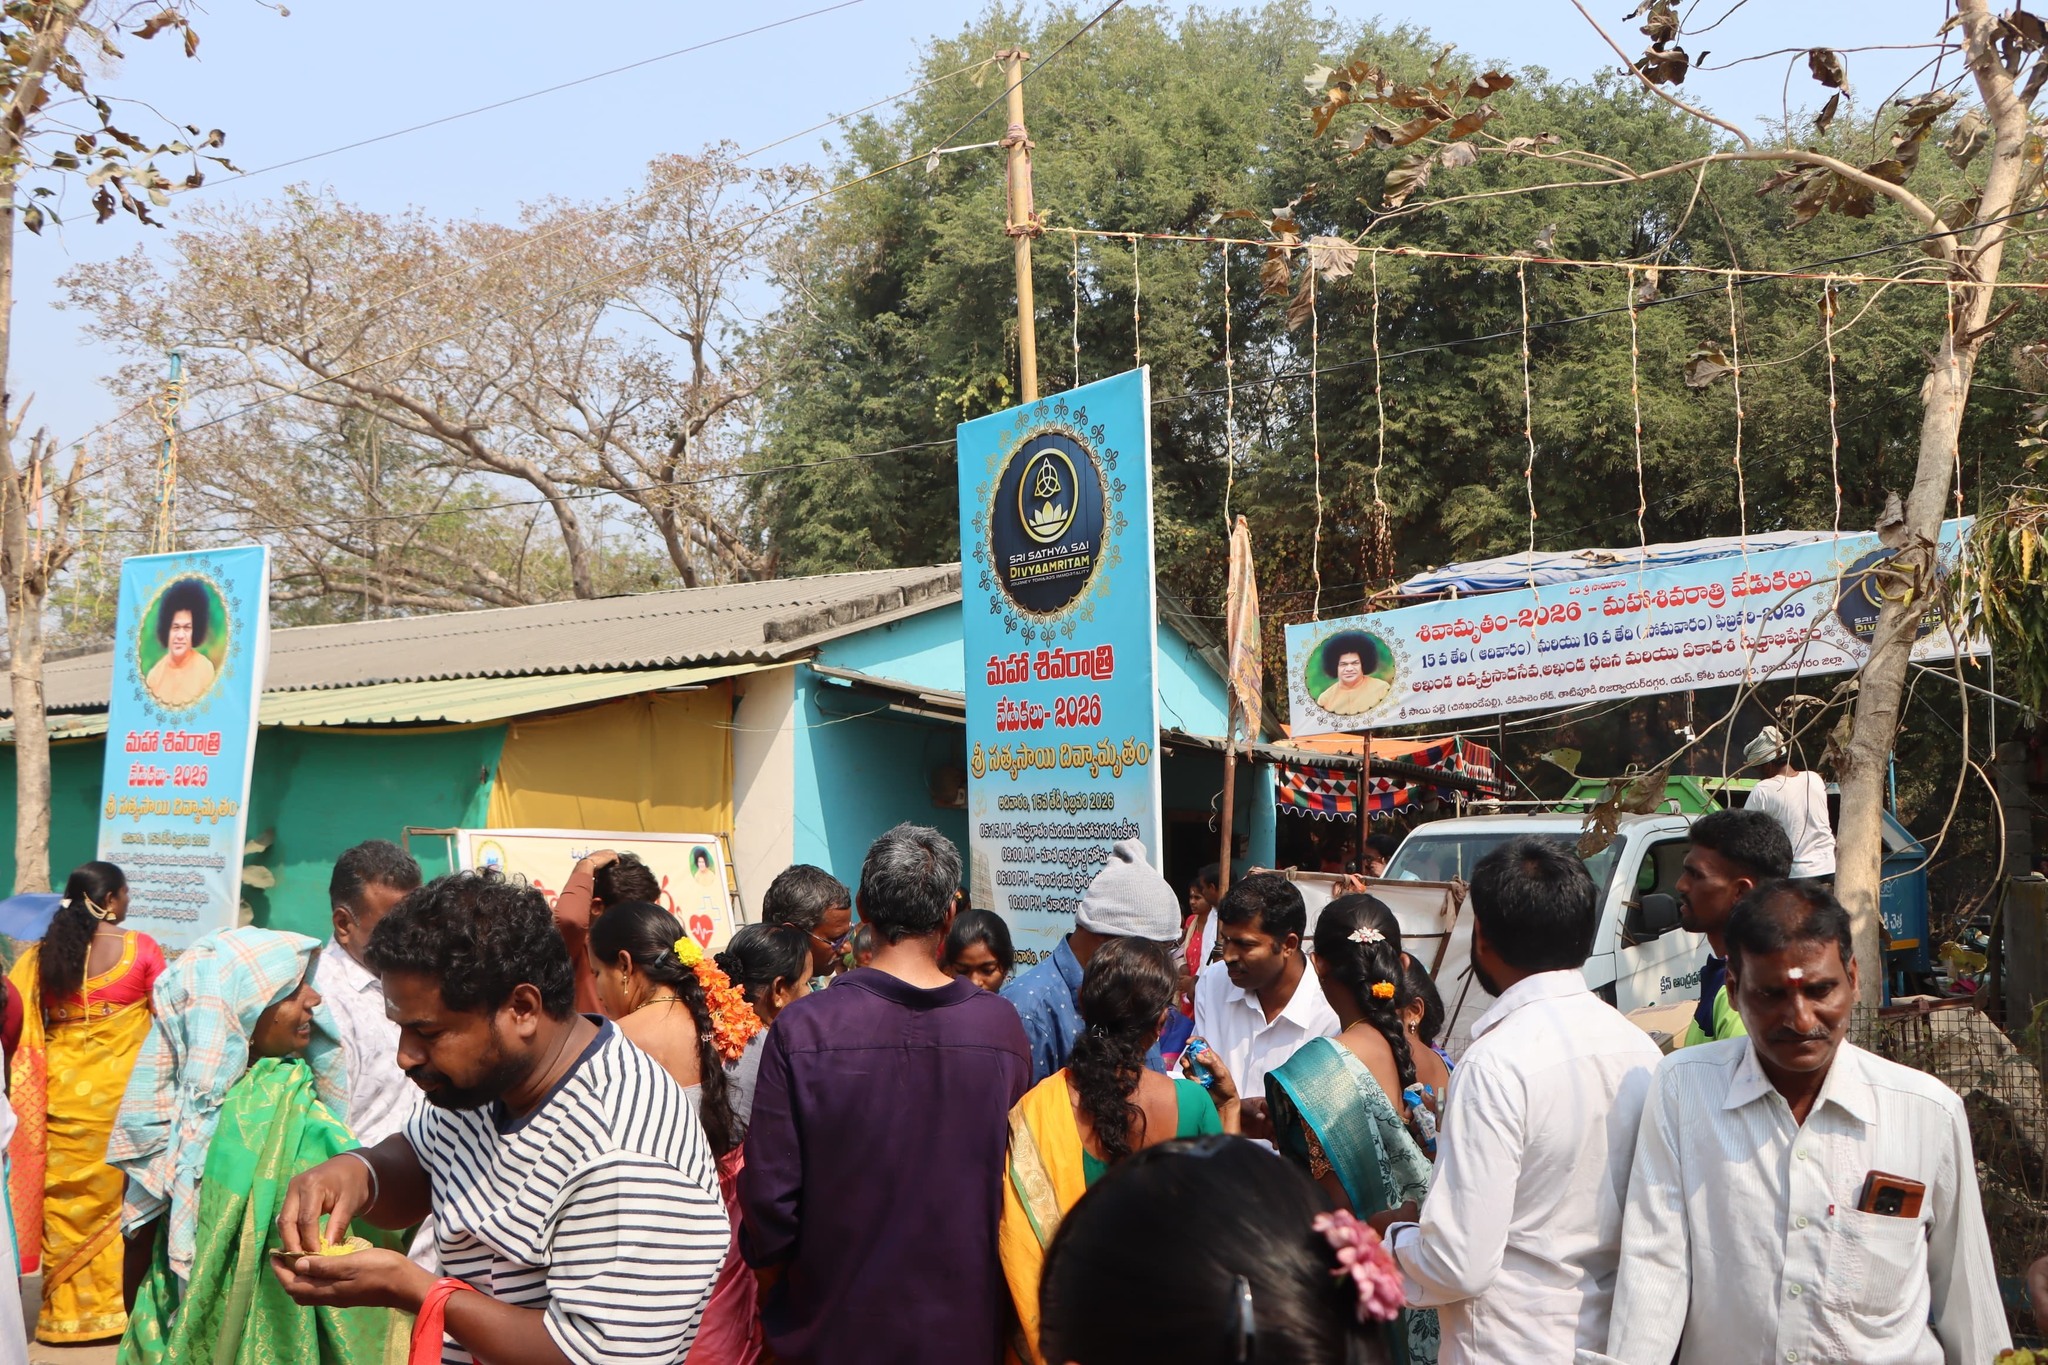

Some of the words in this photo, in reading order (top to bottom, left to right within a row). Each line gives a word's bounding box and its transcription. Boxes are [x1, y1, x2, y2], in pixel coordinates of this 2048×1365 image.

[1009, 553, 1026, 564] SRI
[1028, 545, 1068, 560] SATHYA
[1071, 541, 1089, 552] SAI
[1010, 555, 1090, 579] DIVYAAMRITAM
[1415, 601, 1582, 644] శివామృతం-2026
[1602, 582, 1726, 617] మహాశివరాత్రి
[1731, 570, 1812, 599] వేడుకలు
[1422, 653, 1436, 669] 15
[1438, 653, 1448, 666] వ
[1537, 634, 1581, 654] మరియు
[1583, 632, 1598, 647] 16
[1602, 630, 1612, 644] వ
[1715, 602, 1806, 632] ఫిబ్రవరి-2026
[986, 651, 1029, 686] మహా
[1033, 644, 1115, 681] శివరాత్రి
[1412, 675, 1453, 693] అఖండ
[1590, 654, 1621, 673] భజన
[1625, 645, 1679, 665] మరియు
[1683, 638, 1736, 658] ఏకాదశ
[1740, 627, 1822, 653] రుద్రాభిషేకం
[1399, 708, 1408, 720] శ్రీ
[1408, 707, 1431, 716] సాయి
[1696, 670, 1716, 681] కోట
[1054, 693, 1102, 728] 2026
[125, 730, 160, 753] మహా
[162, 729, 222, 757] శివరాత్రి
[971, 740, 986, 779] శ్రీ
[988, 742, 1056, 781] సత్యసాయి
[1059, 736, 1150, 779] దివ్యామృతం
[173, 765, 208, 788] 2026
[105, 793, 117, 821] శ్రీ
[119, 795, 170, 823] సత్యసాయి
[173, 795, 239, 825] దివ్యామృతం
[1089, 792, 1114, 811] 2026
[979, 823, 1000, 838] 05:15
[1000, 823, 1012, 838] AM
[1049, 823, 1076, 839] మరియు
[1002, 847, 1023, 862] 09:00
[1023, 847, 1036, 863] AM
[996, 871, 1017, 885] 06:00
[1017, 871, 1029, 886] PM
[1008, 895, 1030, 910] 10:00
[1030, 895, 1041, 911] PM
